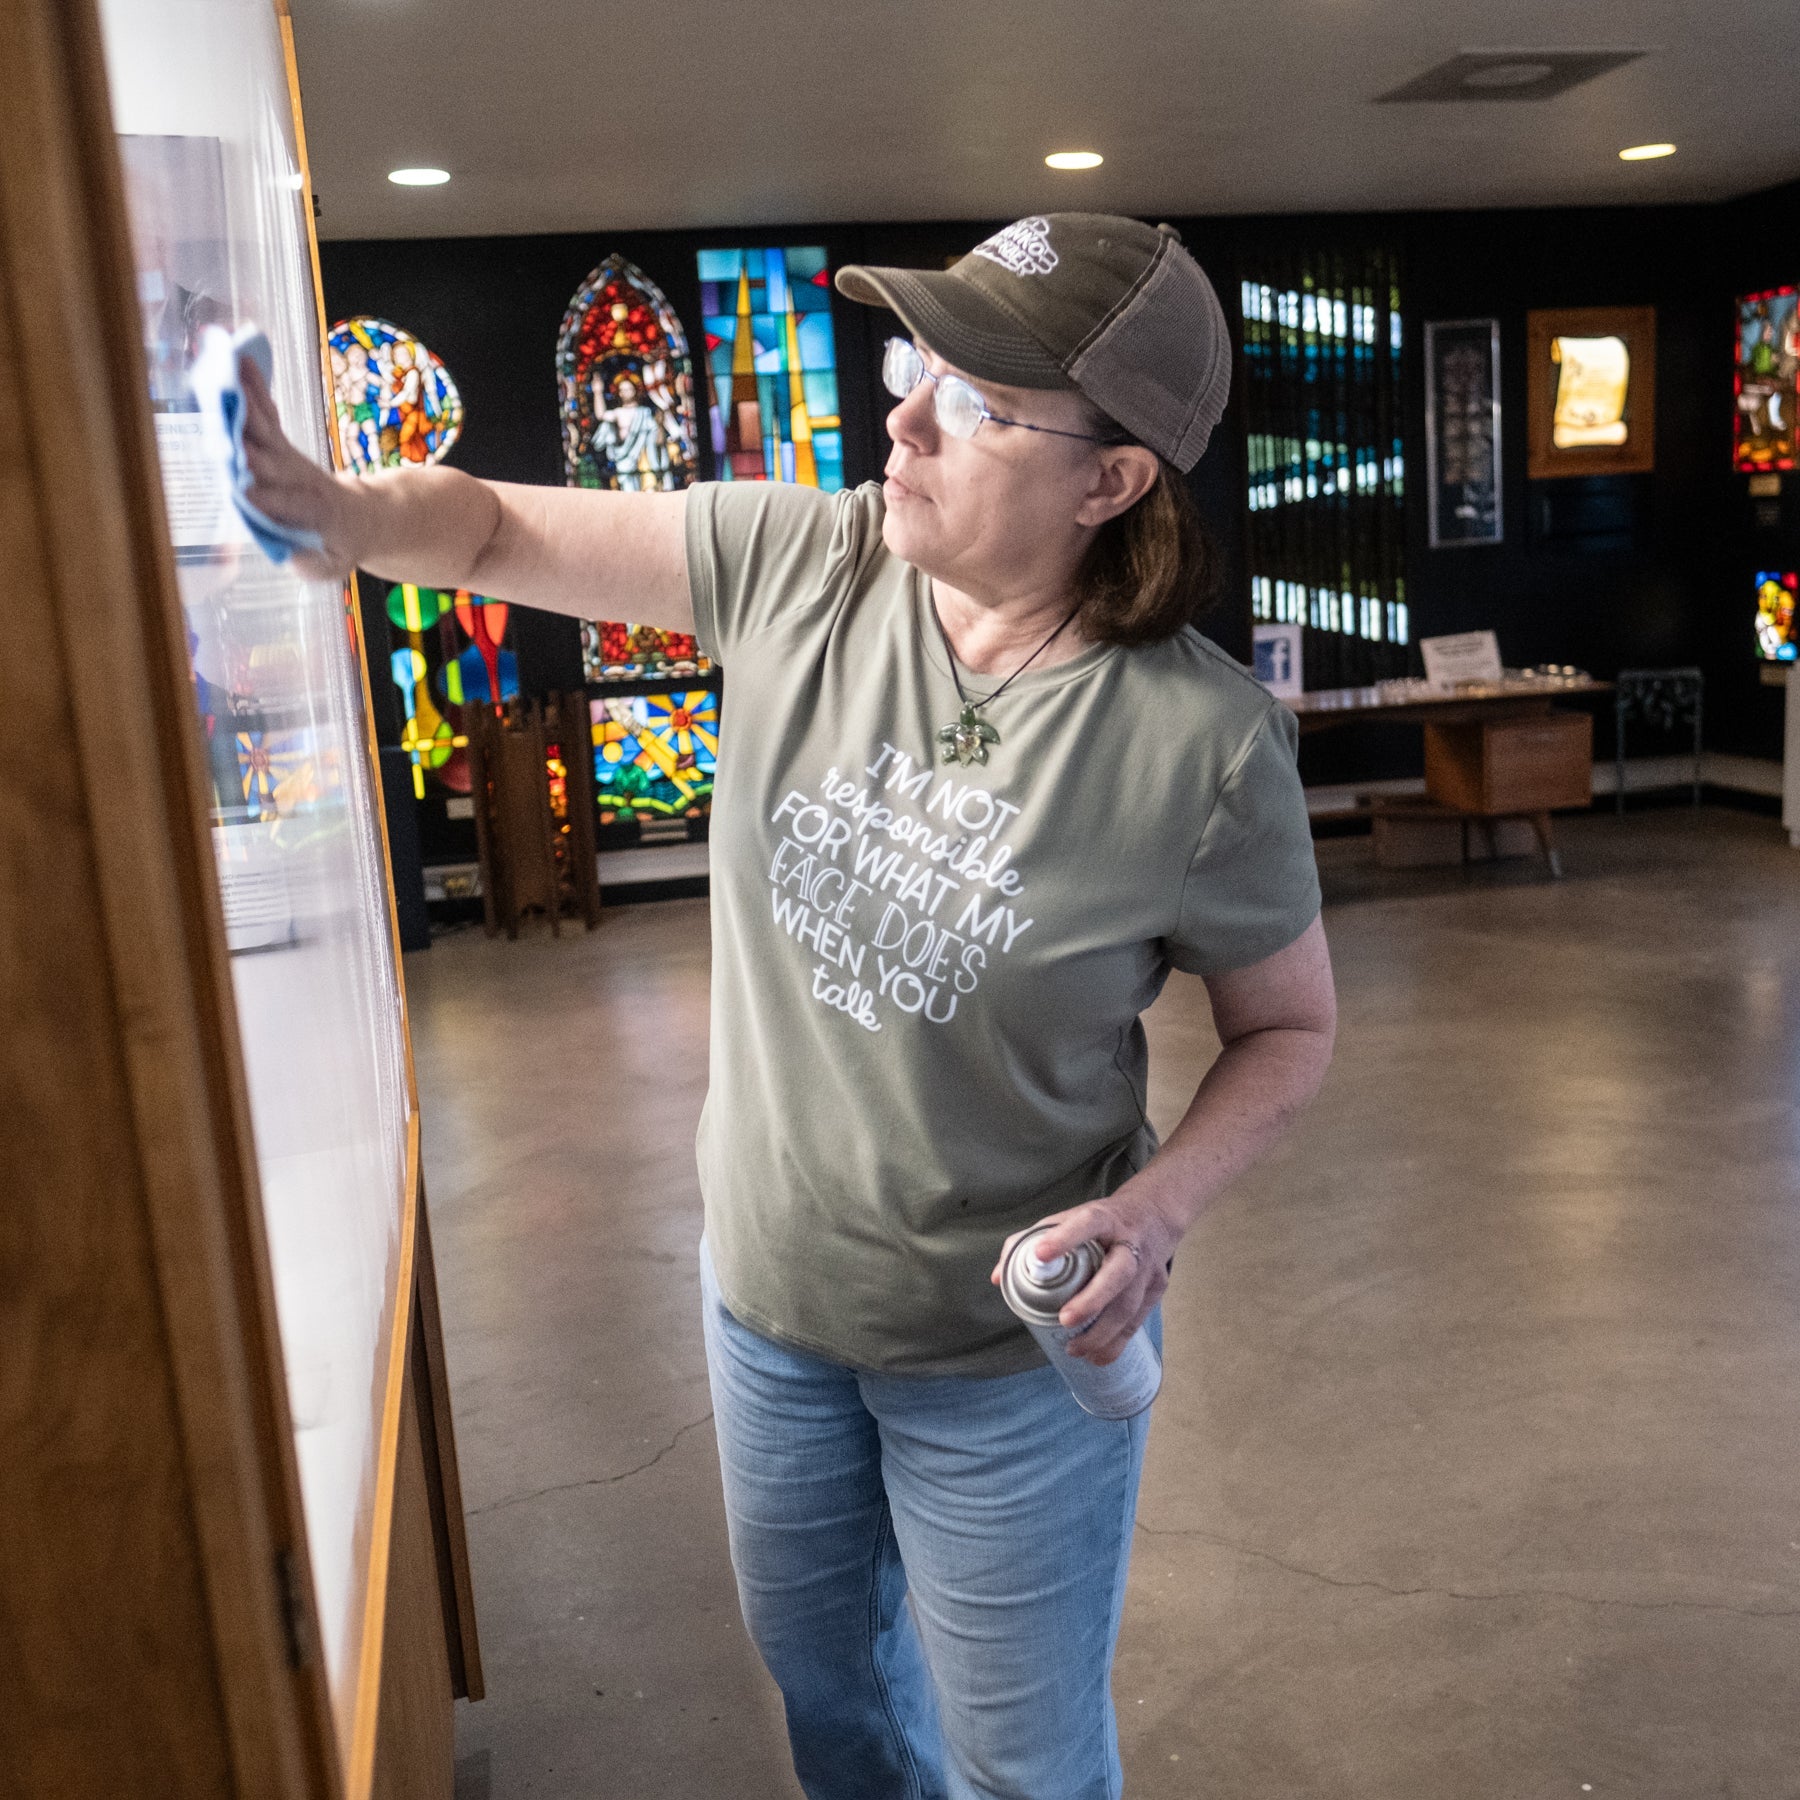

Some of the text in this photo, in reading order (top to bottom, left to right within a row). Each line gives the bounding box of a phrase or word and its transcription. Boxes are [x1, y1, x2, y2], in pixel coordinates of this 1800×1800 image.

[821, 766, 1024, 897] responsible
[865, 742, 1020, 841] I'M NOT
[768, 837, 986, 993] FACE DOES
[771, 791, 1033, 953] FOR WHAT MY
[771, 888, 958, 1023] WHEN YOU
[812, 964, 882, 1031] talk
